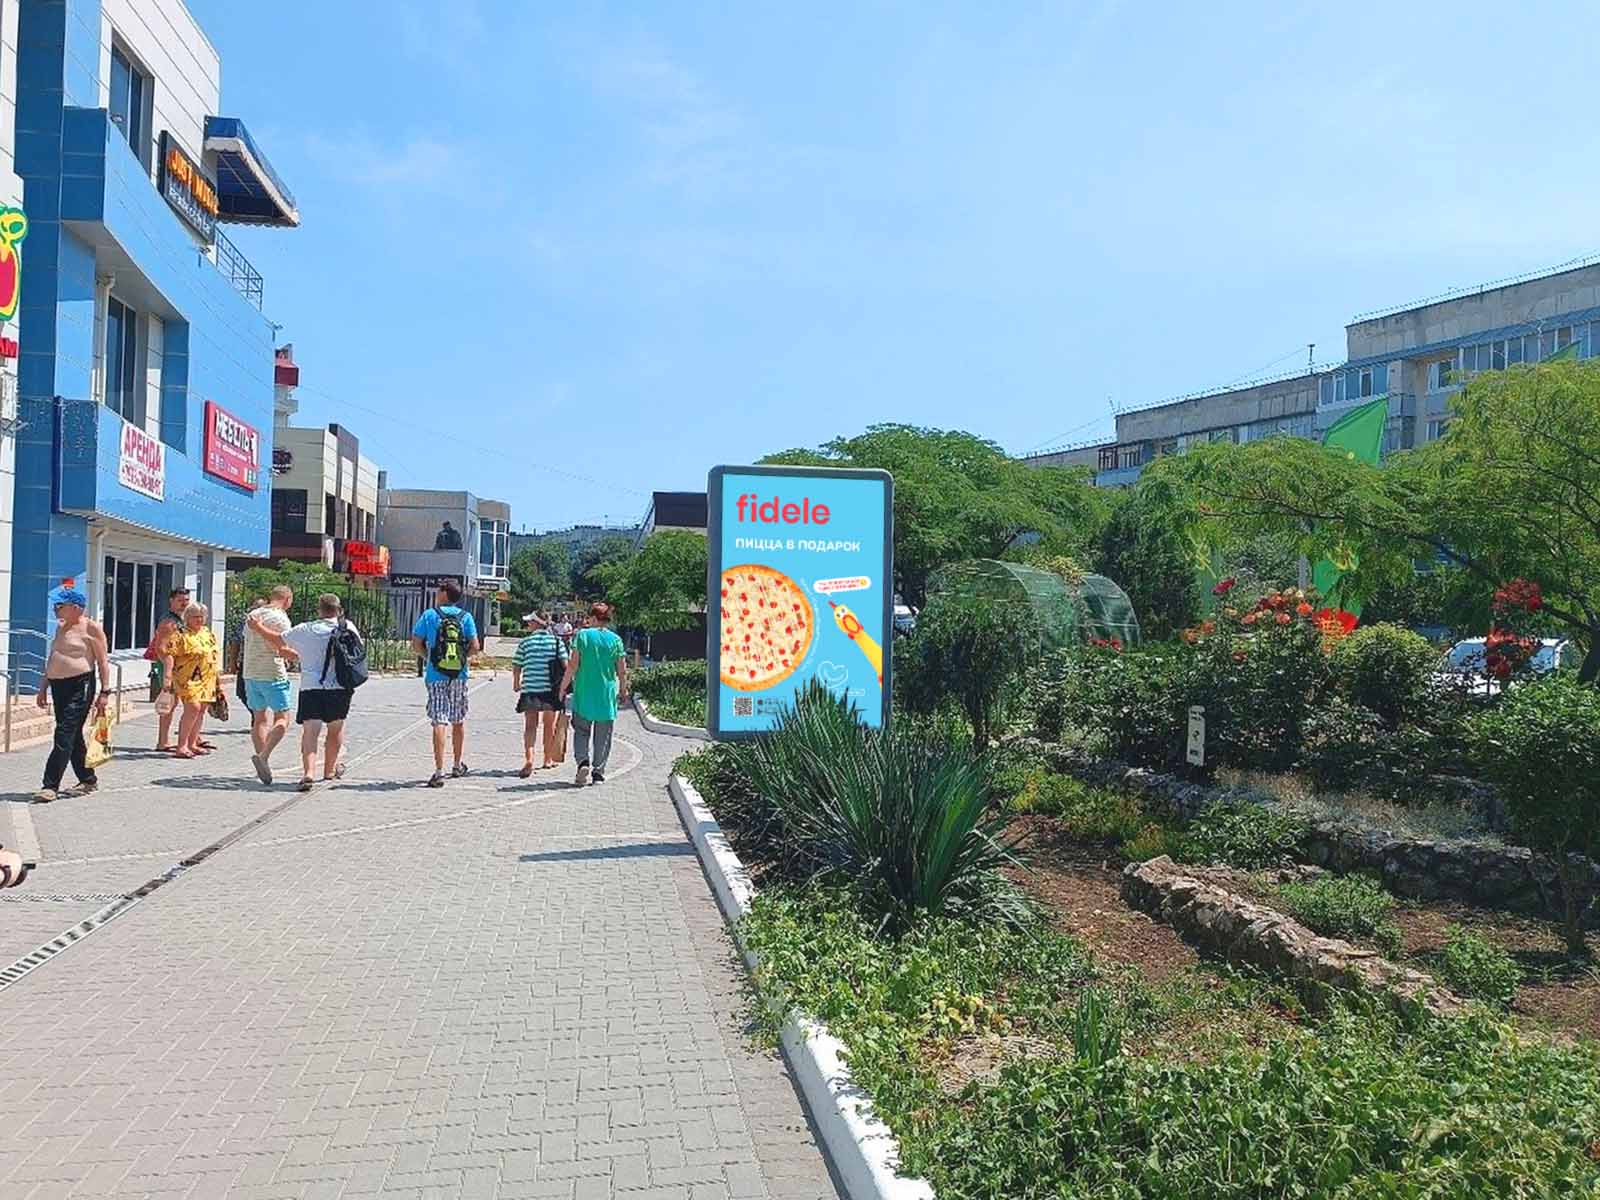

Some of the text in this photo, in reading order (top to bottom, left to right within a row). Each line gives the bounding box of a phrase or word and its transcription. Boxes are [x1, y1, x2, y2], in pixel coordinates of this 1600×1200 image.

[123, 425, 162, 472] АРЕНДА
[736, 493, 831, 525] fidele
[735, 538, 861, 552] ПИЦЦА В ПОДАРОК
